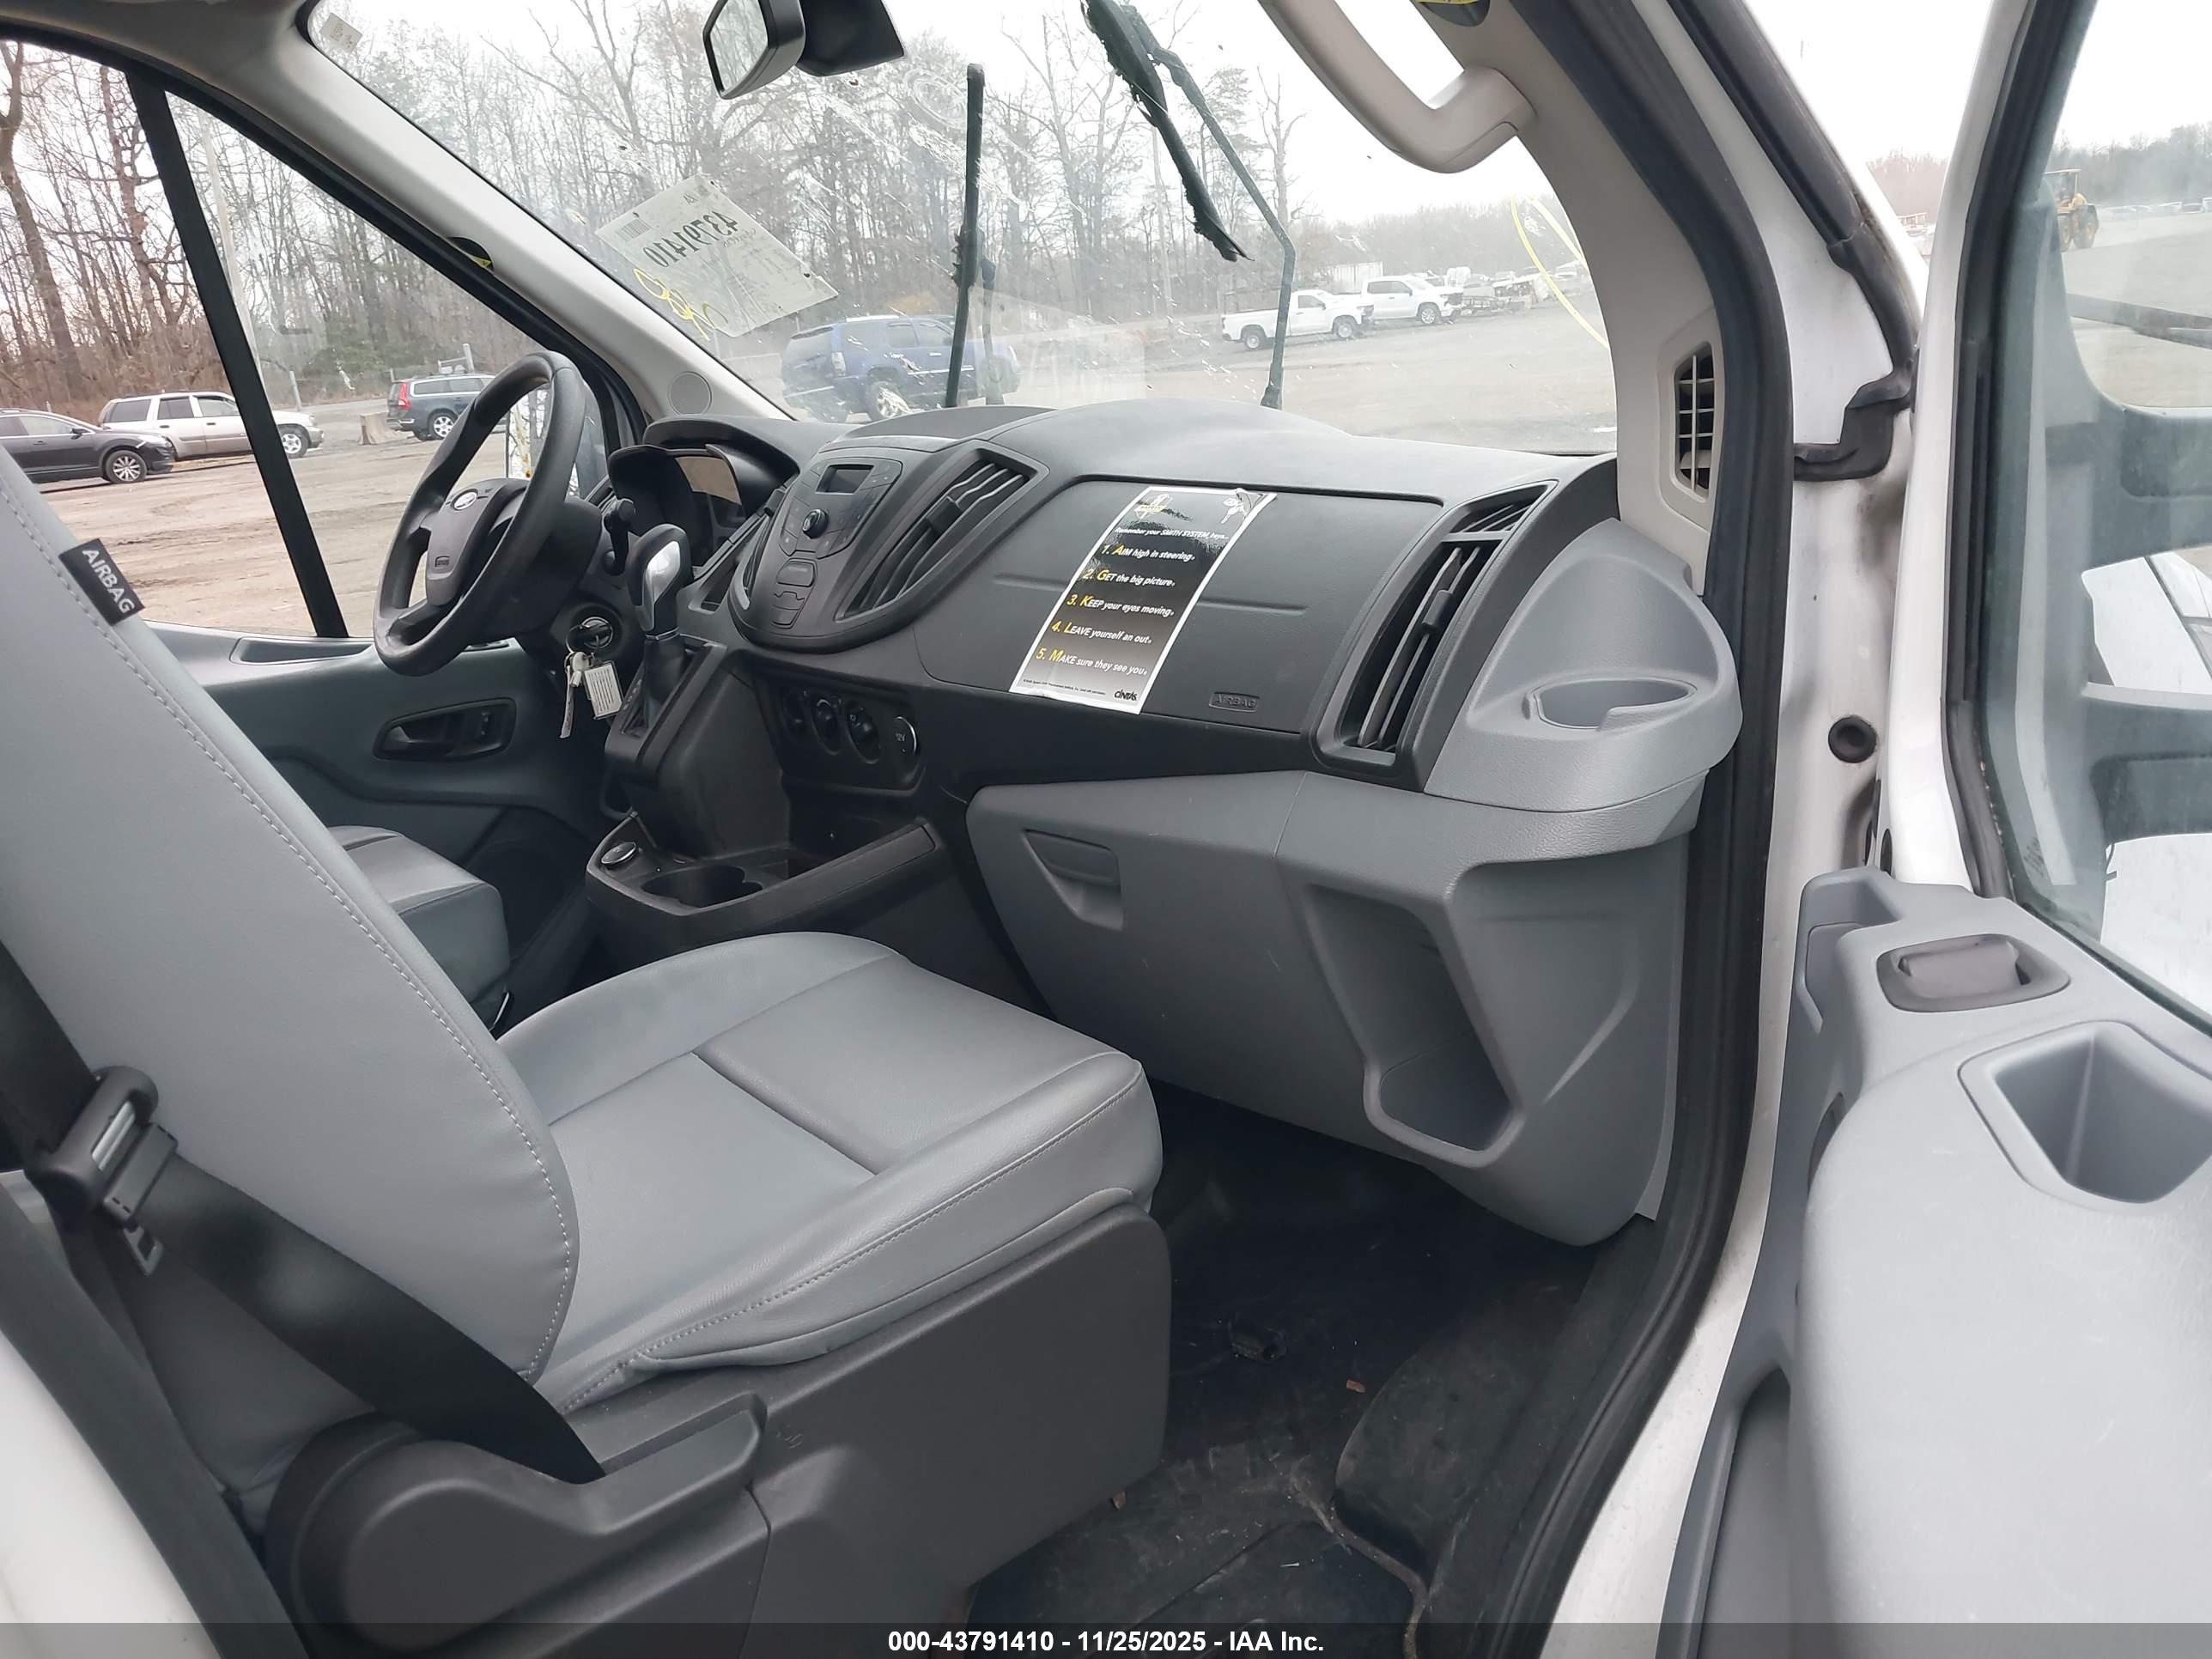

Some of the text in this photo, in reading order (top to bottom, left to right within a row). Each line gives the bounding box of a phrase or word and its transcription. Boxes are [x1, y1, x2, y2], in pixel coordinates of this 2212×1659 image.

[1102, 544, 1109, 555] 1.
[1132, 549, 1150, 559] high
[1150, 550, 1159, 558] in
[82, 550, 135, 614] AIRBAG
[1083, 568, 1092, 580] 2.
[1097, 569, 1116, 581] GET
[1116, 573, 1130, 582] the
[1130, 574, 1144, 585] big
[1066, 594, 1077, 605] 3.
[1079, 595, 1104, 608] KEEP
[1103, 601, 1122, 611] your
[1121, 603, 1140, 613] eyes
[1051, 621, 1060, 633] 4.
[1064, 622, 1091, 636] LEAVE
[1091, 629, 1123, 640] yourself
[1036, 647, 1045, 659] 5.
[1048, 649, 1077, 665] MAKE
[1076, 658, 1094, 667] sure
[1094, 659, 1113, 672] they
[1113, 664, 1128, 673] see
